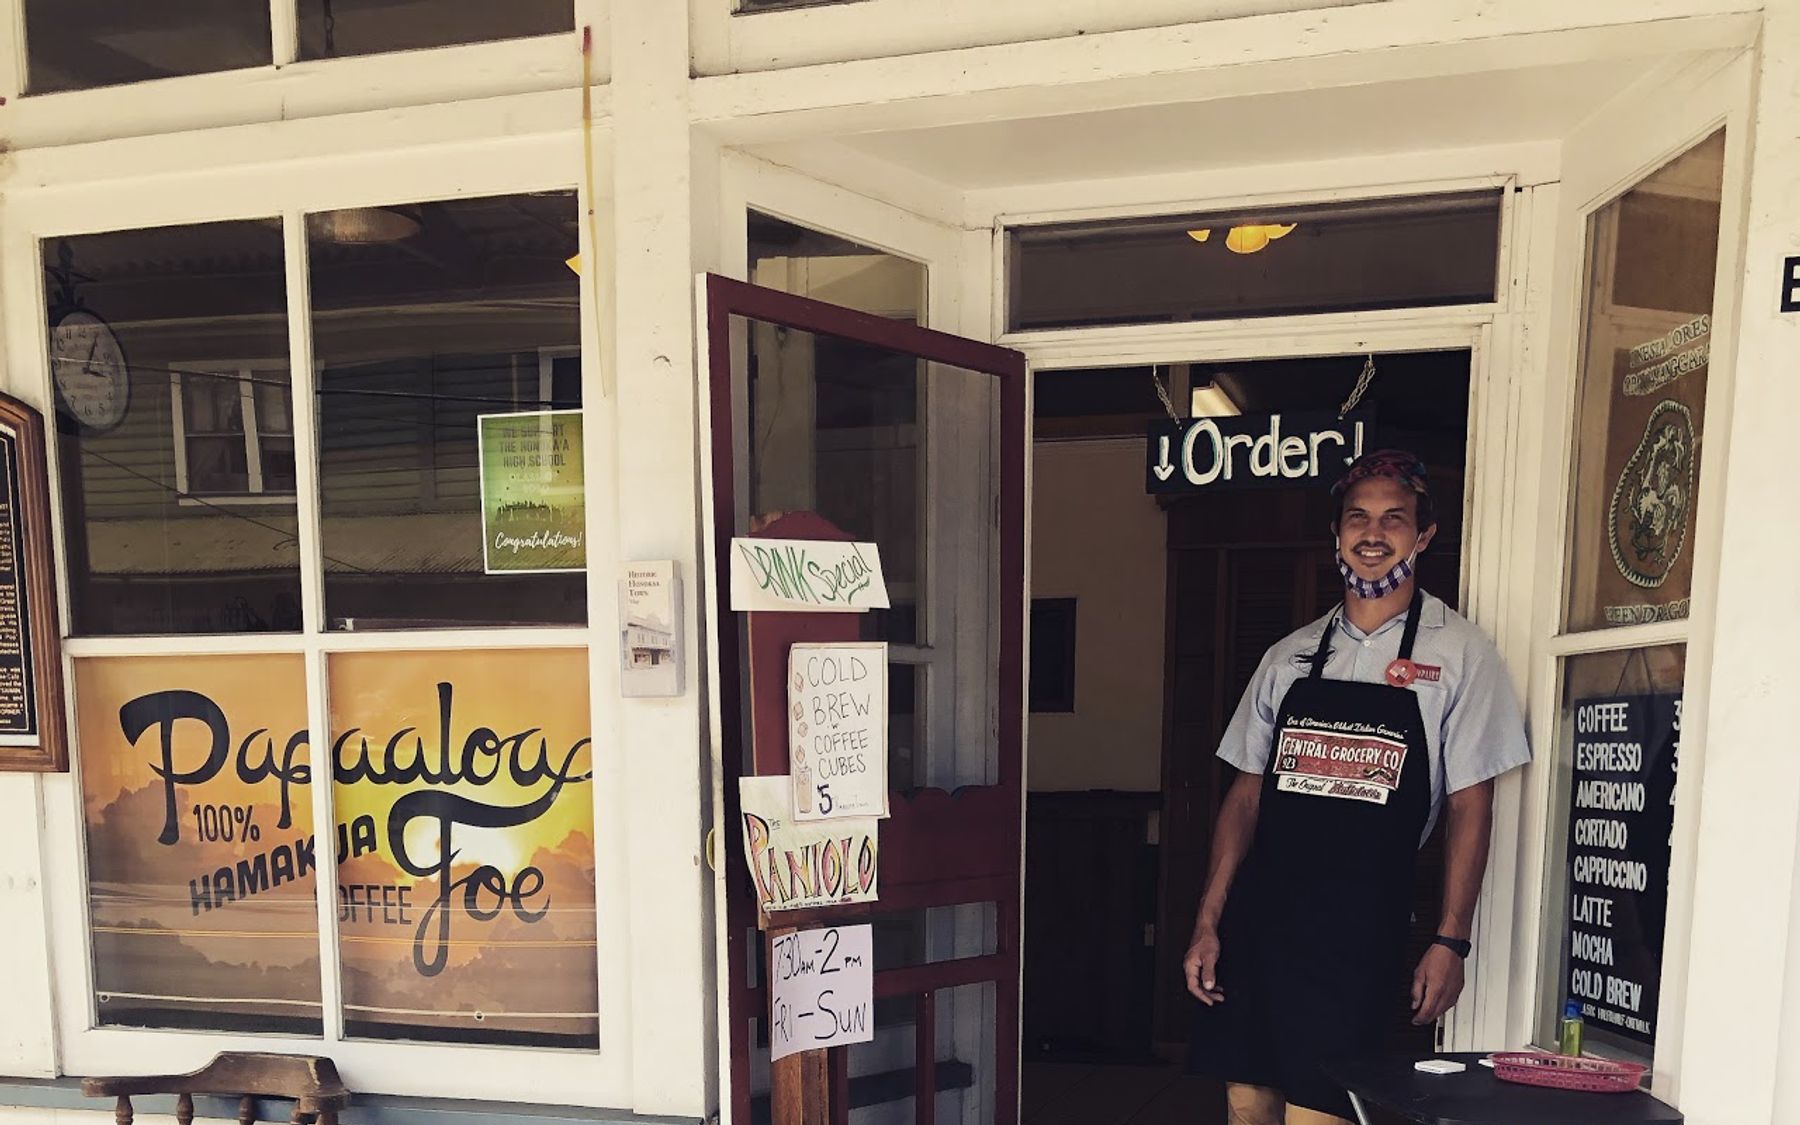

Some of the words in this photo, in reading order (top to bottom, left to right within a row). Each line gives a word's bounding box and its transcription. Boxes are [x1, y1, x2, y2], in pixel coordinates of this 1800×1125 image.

[521, 423, 564, 438] SUPRT
[503, 455, 526, 469] HIGH
[1181, 414, 1345, 485] Order
[494, 530, 583, 554] Congratulations!
[808, 656, 868, 688] COLD
[812, 691, 871, 726] BREW
[1577, 702, 1630, 734] COFFEE
[814, 728, 869, 755] COFFEE
[1282, 737, 1328, 759] CENTRAL
[1330, 745, 1382, 765] GROCERY
[1576, 742, 1642, 772] ESPRESSO
[818, 753, 866, 780] CUBES
[816, 783, 833, 815] 5
[1575, 780, 1645, 813] AMERICANO
[192, 804, 260, 843] 100%
[1574, 818, 1627, 851] CORTADO
[743, 812, 876, 904] PANIOLO
[1573, 855, 1648, 893] CAPPUCCINO
[387, 789, 563, 977] Joe
[314, 884, 412, 926] OFFEE
[1573, 894, 1613, 928] LATTE
[1572, 930, 1614, 967] MOCHA
[1572, 968, 1602, 1001] COLD
[1606, 975, 1642, 1013] BREW
